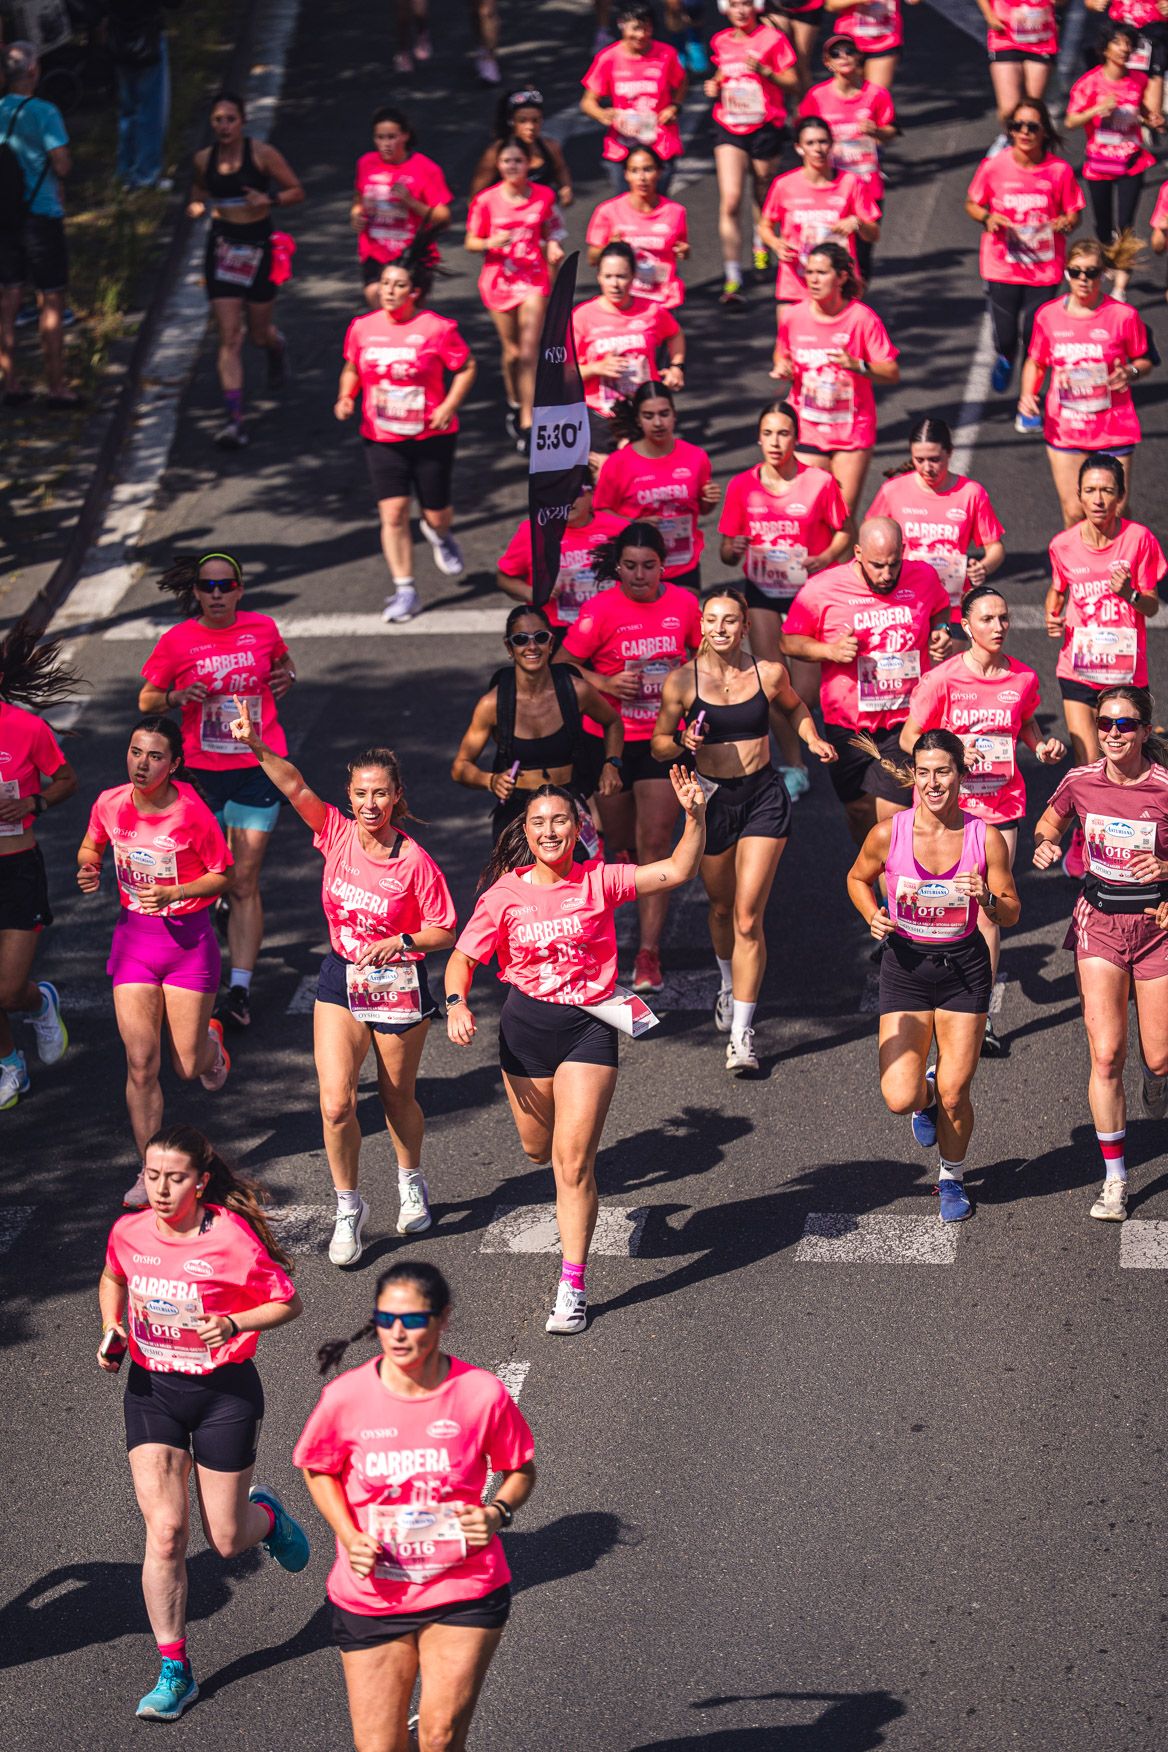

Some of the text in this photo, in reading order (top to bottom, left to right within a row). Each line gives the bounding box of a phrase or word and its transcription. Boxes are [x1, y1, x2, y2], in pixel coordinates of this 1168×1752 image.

[637, 484, 689, 505] CARRERA
[905, 521, 960, 541] CARRERA
[1072, 579, 1113, 600] CARRE
[854, 606, 913, 631] CARRERA
[1101, 599, 1119, 622] DE
[621, 636, 678, 658] CARRERA
[196, 651, 256, 676] CARRERA
[1092, 653, 1116, 665] 016
[229, 673, 250, 692] DE
[879, 679, 902, 690] 016
[952, 708, 1012, 727] CARRERA
[1105, 846, 1131, 859] 016
[133, 871, 156, 885] 016
[331, 877, 389, 917] CARRERA
[918, 907, 945, 917] 016
[517, 915, 584, 943] CARRERA
[557, 941, 579, 963] DE
[371, 991, 398, 1001] 016
[133, 1253, 161, 1266] OYSHO
[130, 1275, 198, 1301] CARRERA
[148, 1303, 178, 1314] ASTURIANA
[151, 1324, 182, 1339] 016
[365, 1447, 451, 1478] CARRERA
[410, 1479, 438, 1506] DE
[399, 1540, 435, 1557] 016
